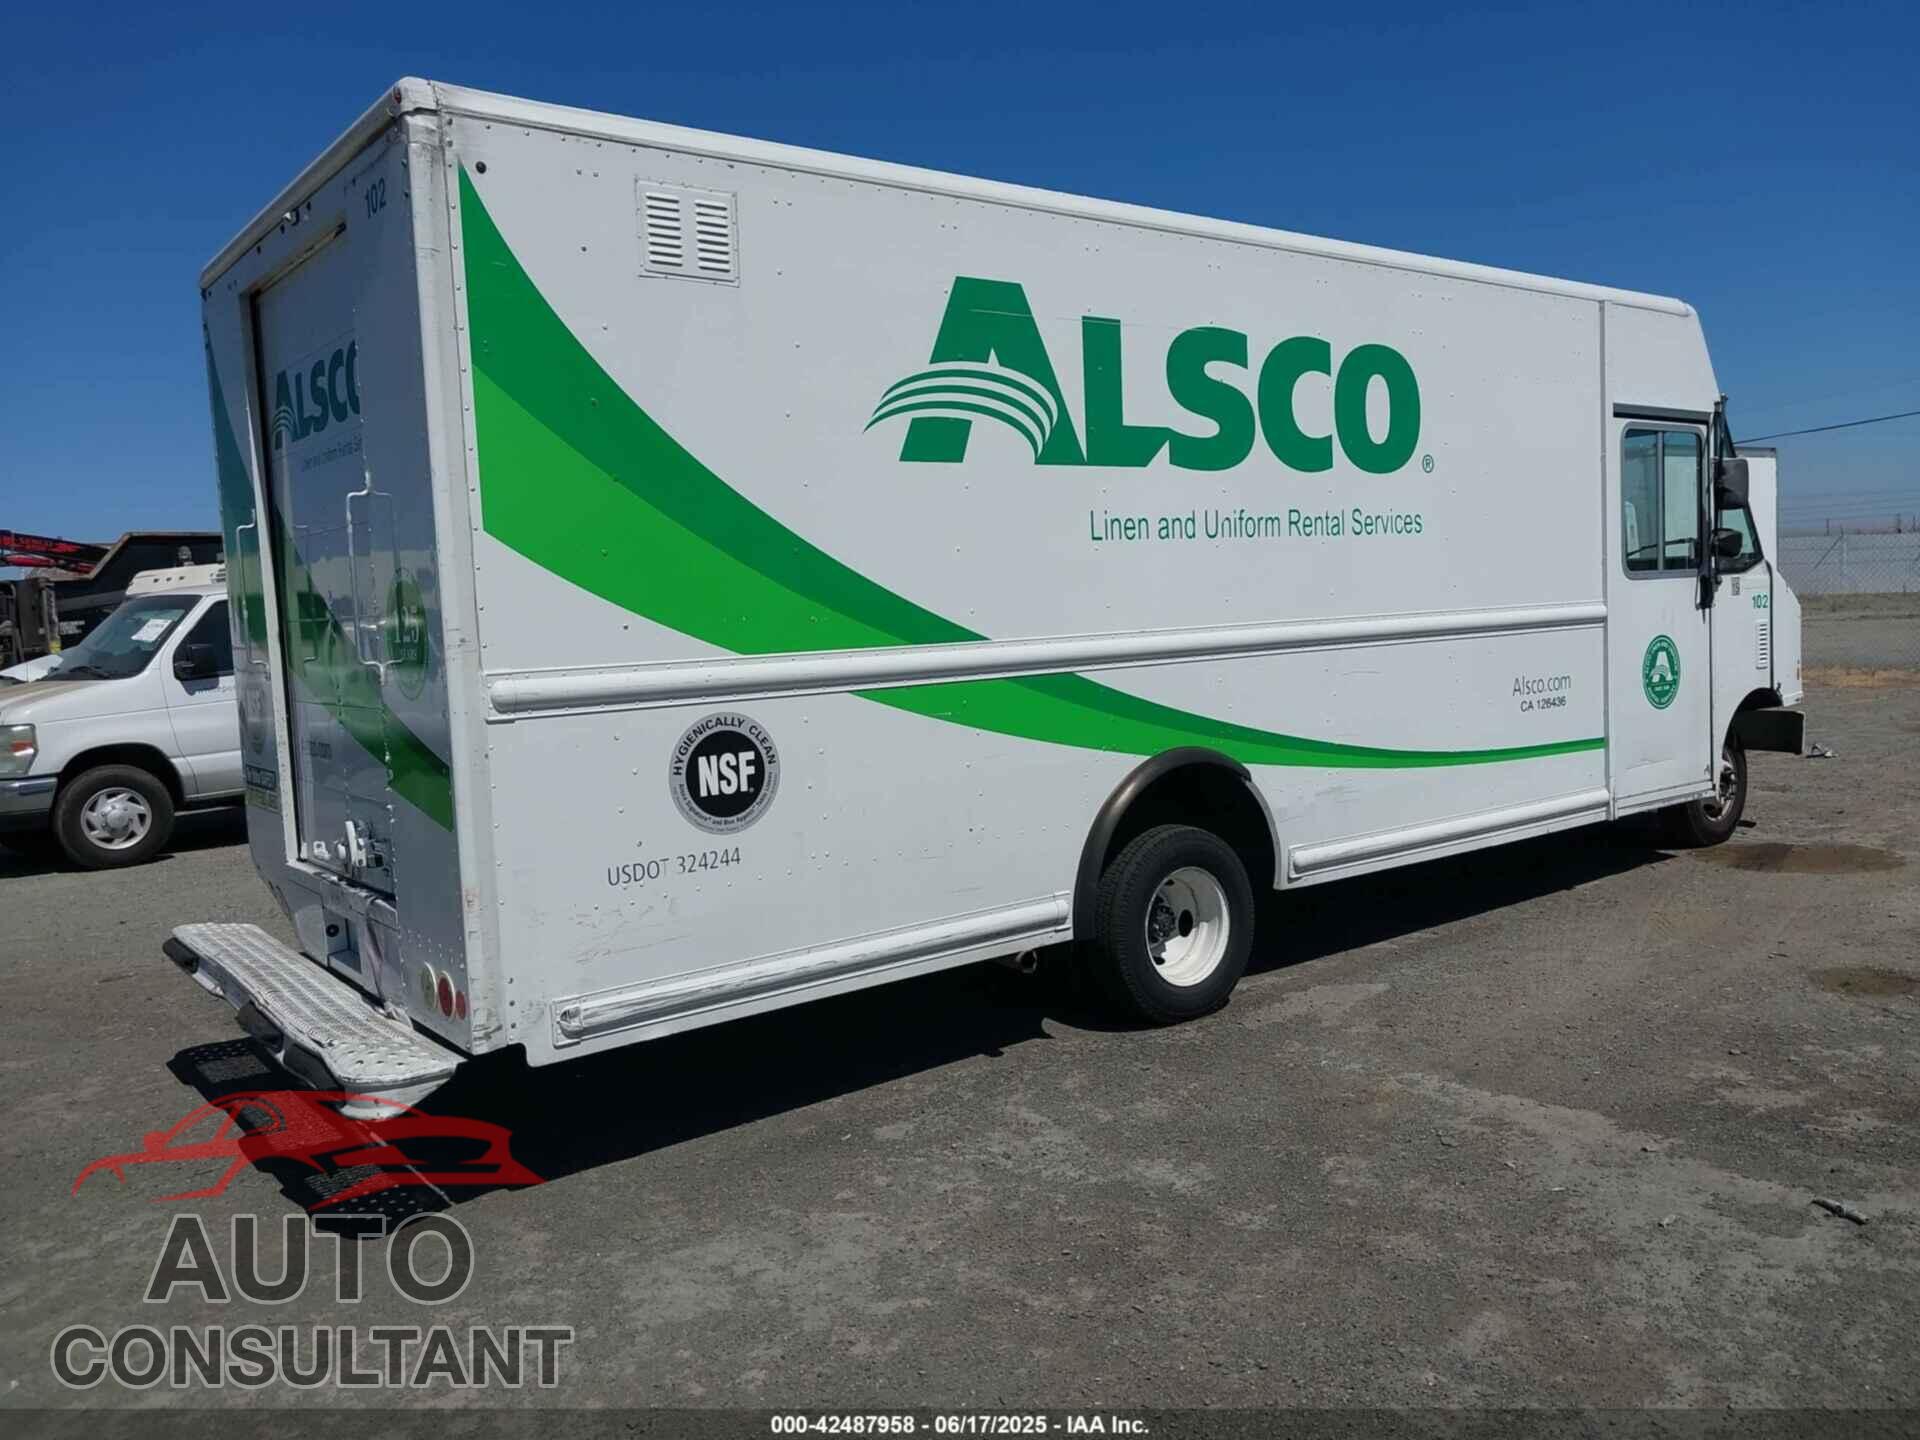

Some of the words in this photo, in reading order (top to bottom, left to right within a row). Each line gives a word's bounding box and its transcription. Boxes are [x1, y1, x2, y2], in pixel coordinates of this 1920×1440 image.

[366, 176, 387, 220] 102
[863, 275, 1421, 474] ALSCO
[1090, 509, 1150, 541] Linen
[1157, 509, 1196, 540] and
[1204, 508, 1281, 539] Uniform
[1288, 508, 1345, 537] Rental
[1351, 507, 1424, 536] Services
[1751, 594, 1769, 609] 102
[1512, 675, 1572, 697] Alsco.com
[1520, 700, 1534, 713] CA
[672, 716, 746, 777] HYGIENICALLY
[747, 724, 777, 765] CLEAN
[697, 750, 756, 798] NSF
[607, 857, 670, 887] USDOT
[676, 847, 742, 874] 324244
